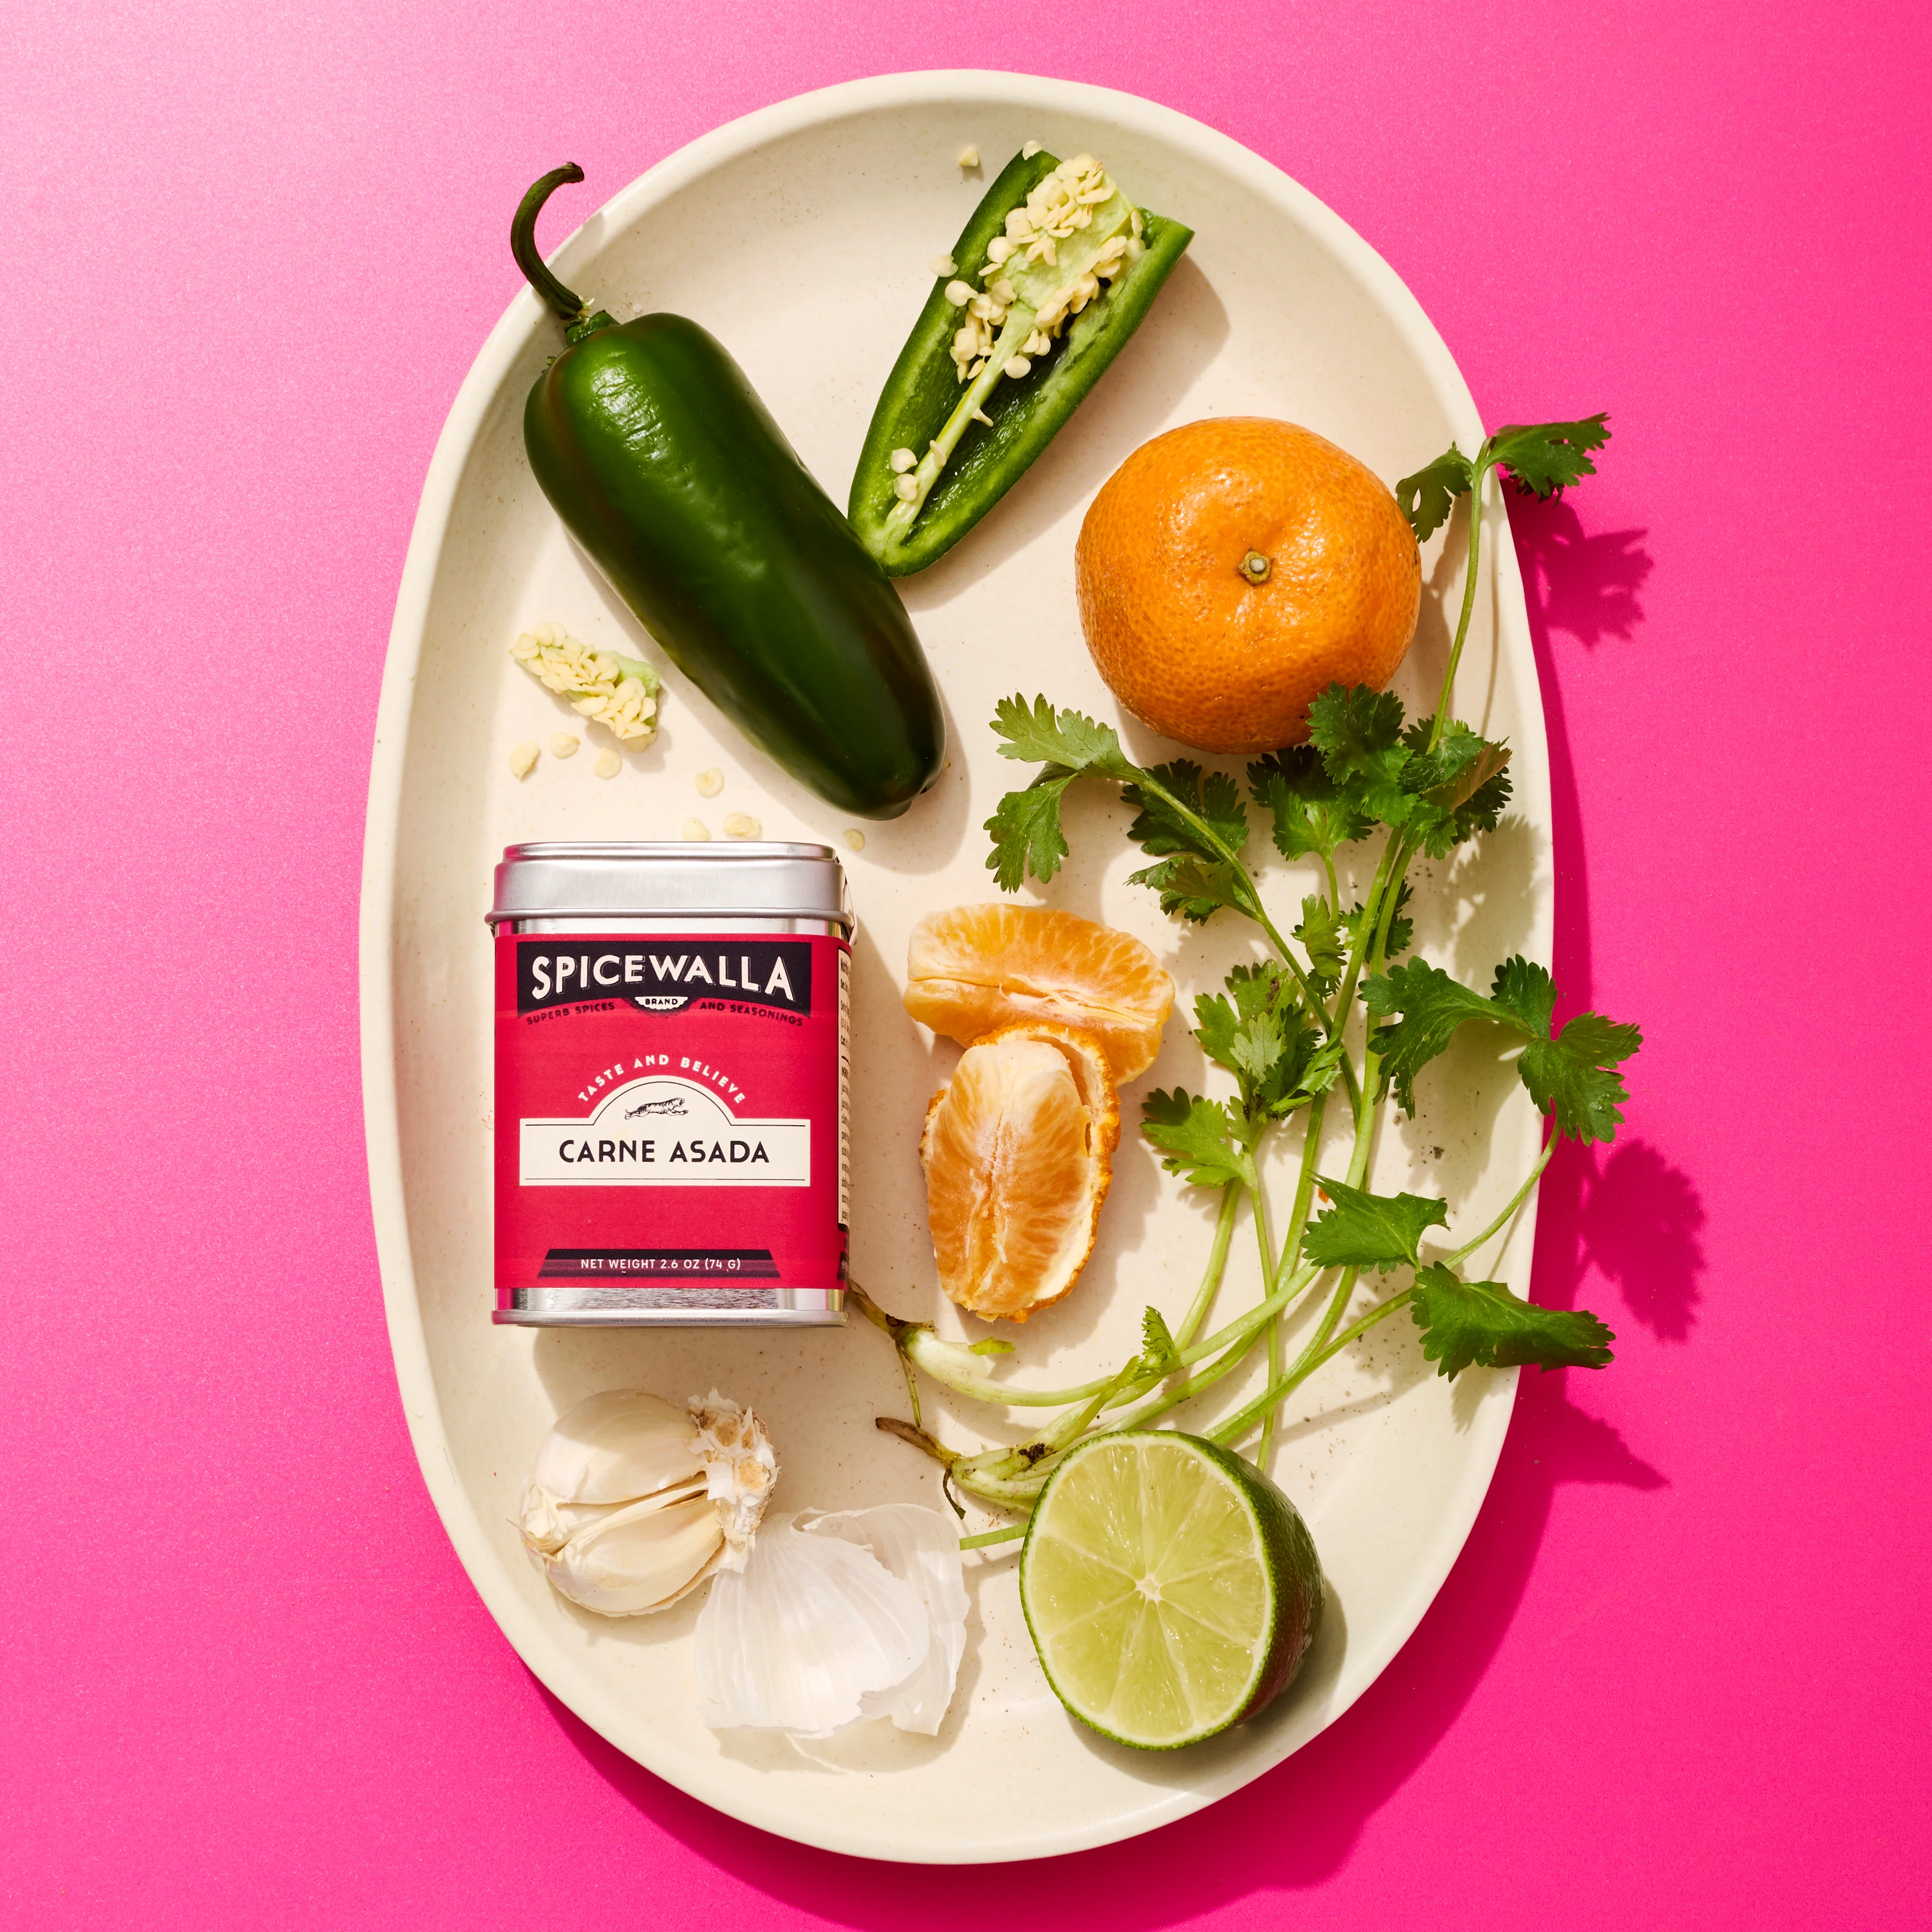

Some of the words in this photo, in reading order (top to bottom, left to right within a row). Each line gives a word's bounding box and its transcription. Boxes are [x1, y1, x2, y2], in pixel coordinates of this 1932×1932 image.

[532, 955, 796, 1001] SPICEWALLA
[527, 1009, 570, 1025] SUPERB
[575, 1002, 615, 1014] SPICES
[700, 1002, 725, 1011] AND
[730, 1004, 803, 1026] SEASONINGS
[578, 1063, 624, 1102] TASTE
[634, 1054, 669, 1069] AND
[680, 1057, 746, 1104] BELIEVE
[559, 1140, 655, 1163] CARNE
[669, 1140, 770, 1163] ASADA
[581, 1259, 603, 1269] NET
[609, 1259, 656, 1269] WEIGHT
[660, 1259, 678, 1269] 2.6
[683, 1259, 700, 1269] OZ
[705, 1258, 723, 1270] (74
[728, 1258, 741, 1270] G)
